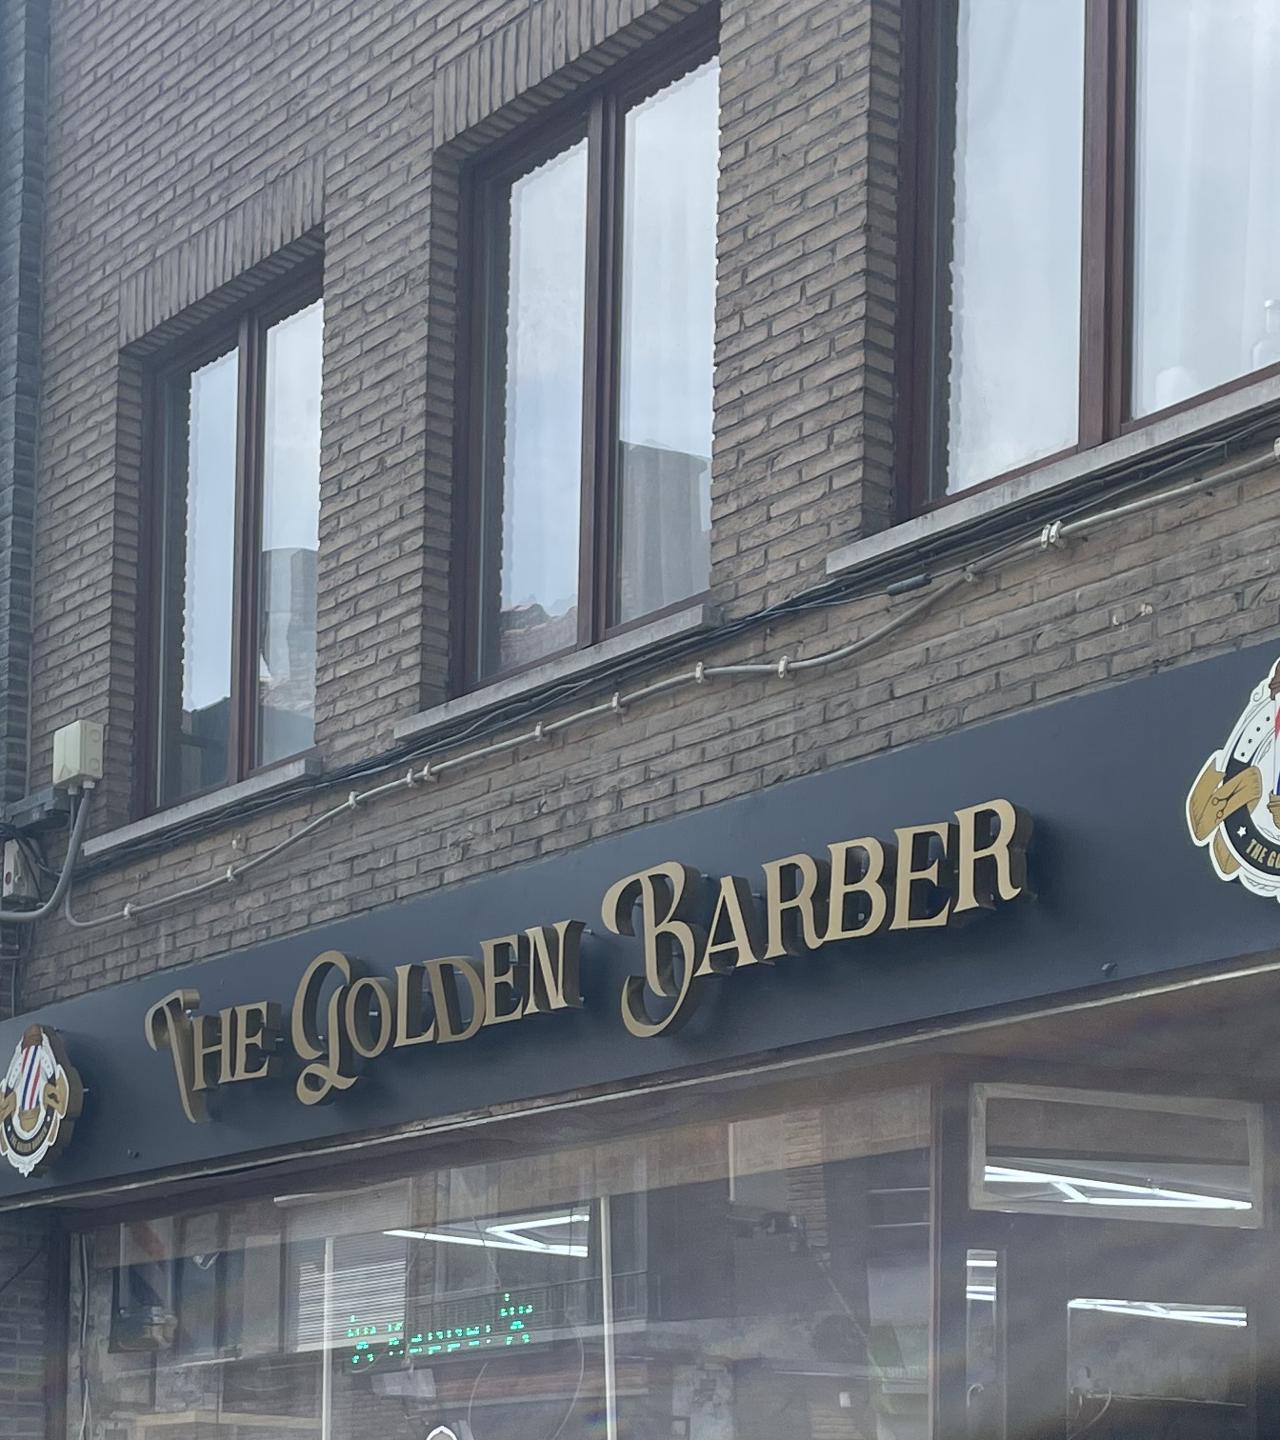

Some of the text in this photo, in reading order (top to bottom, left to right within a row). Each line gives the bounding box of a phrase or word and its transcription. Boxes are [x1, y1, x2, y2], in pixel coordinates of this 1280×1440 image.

[1246, 839, 1268, 864] THE
[145, 797, 1028, 1124] THE GOLDEN BARBER
